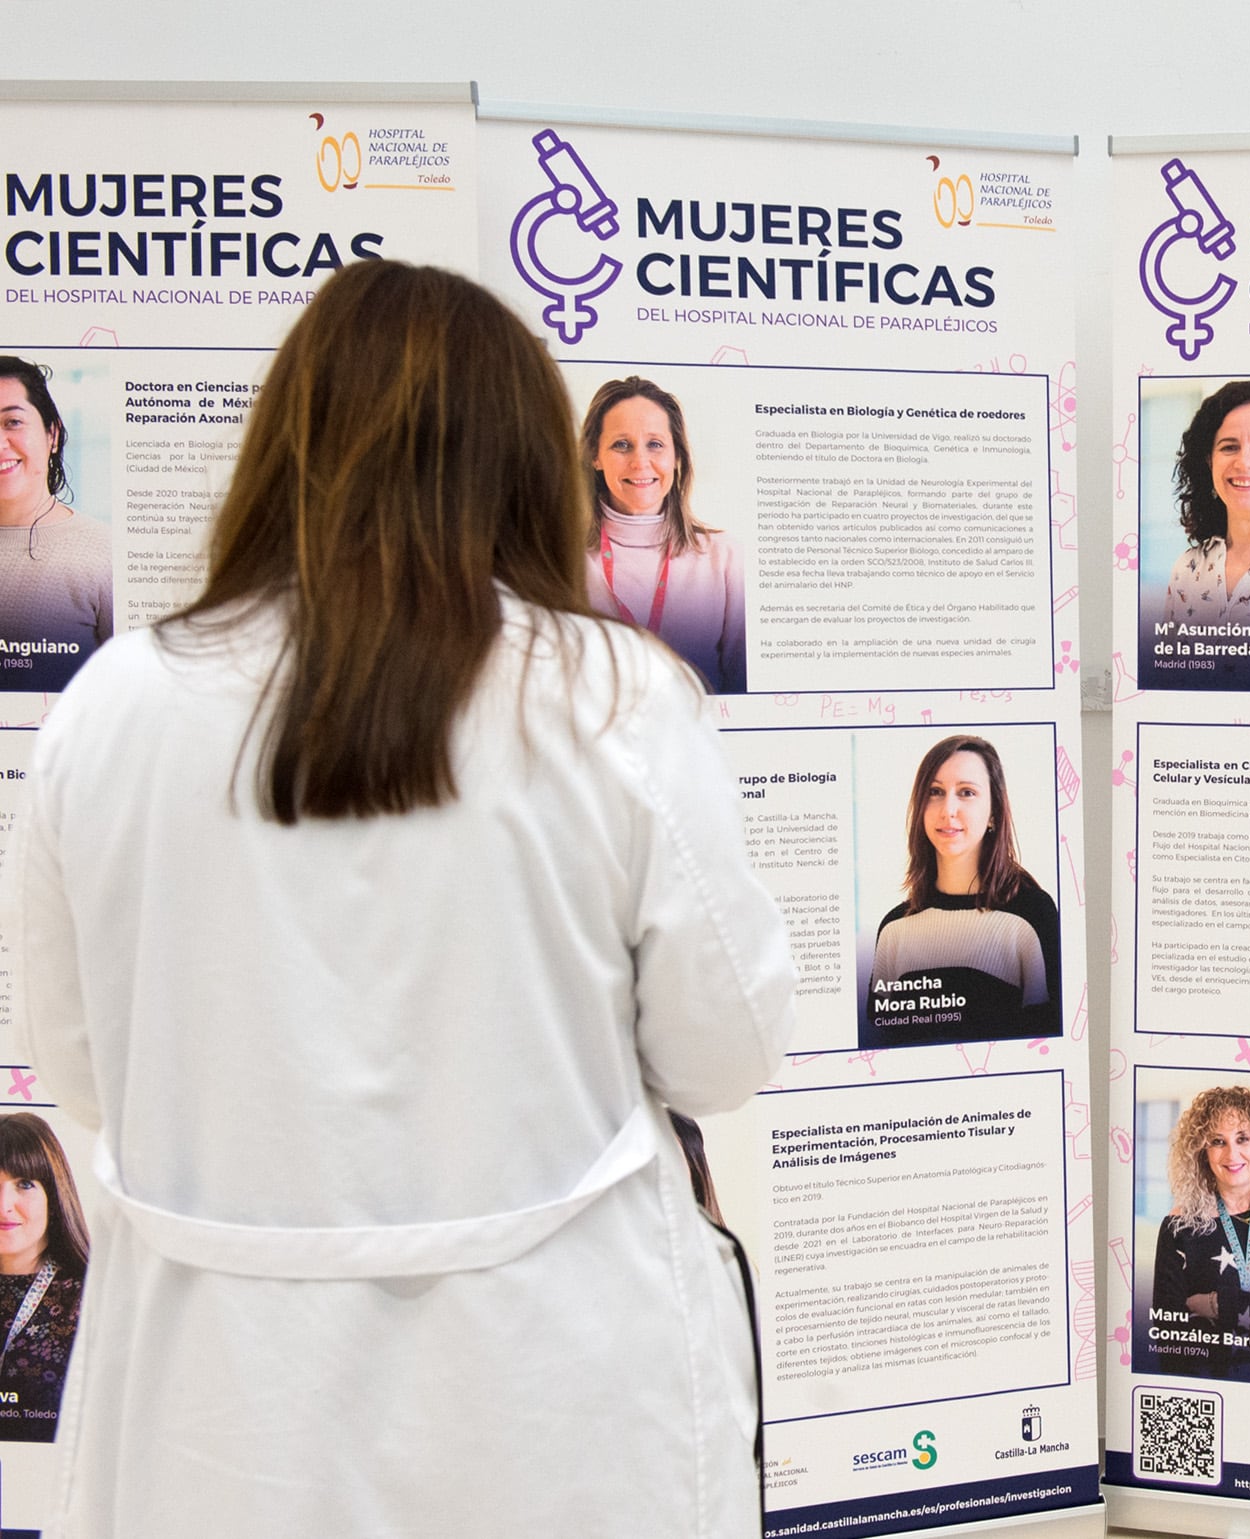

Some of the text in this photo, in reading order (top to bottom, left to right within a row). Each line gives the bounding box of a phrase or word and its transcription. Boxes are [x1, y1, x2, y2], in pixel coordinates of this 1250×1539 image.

[368, 128, 425, 139] HOSPITAL
[368, 142, 448, 152] NACIONAL DE
[368, 154, 450, 168] PARAPLÉJICOS
[417, 173, 451, 183] Toledo
[6, 174, 283, 218] MUJERES
[636, 197, 903, 250] MUJERES
[636, 249, 995, 308] CIENTÍFICAS
[125, 381, 174, 391] Doctora
[176, 383, 192, 392] en
[195, 381, 249, 393] Ciencias
[125, 397, 215, 408] Autónoma de
[125, 412, 243, 424] Reparación Axonal
[755, 404, 1025, 420] Especialista en Biología y Genética de roedores
[1154, 621, 1174, 635] Mª
[1154, 641, 1174, 655] de
[1176, 641, 1190, 655] la
[3, 658, 33, 669] (1983)
[1154, 659, 1215, 670] Madrid (1983)
[1153, 759, 1220, 770] Especialista
[1223, 762, 1238, 770] en
[769, 772, 836, 784] de Biología
[1152, 772, 1192, 783] Celular
[1194, 775, 1201, 786] y
[873, 976, 942, 992] Arancha
[874, 995, 966, 1012] Mora Rubio
[874, 1012, 962, 1027] Ciudad Real (1995)
[771, 1109, 1031, 1140] Especialista en manipulación de Animales de
[772, 1126, 1015, 1154] Experimentación, Procesamiento Tisular y
[772, 1151, 896, 1169] Análisis de Imágenes
[1148, 1307, 1189, 1322] Maru
[1148, 1327, 1220, 1344] González
[1148, 1344, 1209, 1358] Madrid (1974)
[22, 1409, 58, 1419] Toledo
